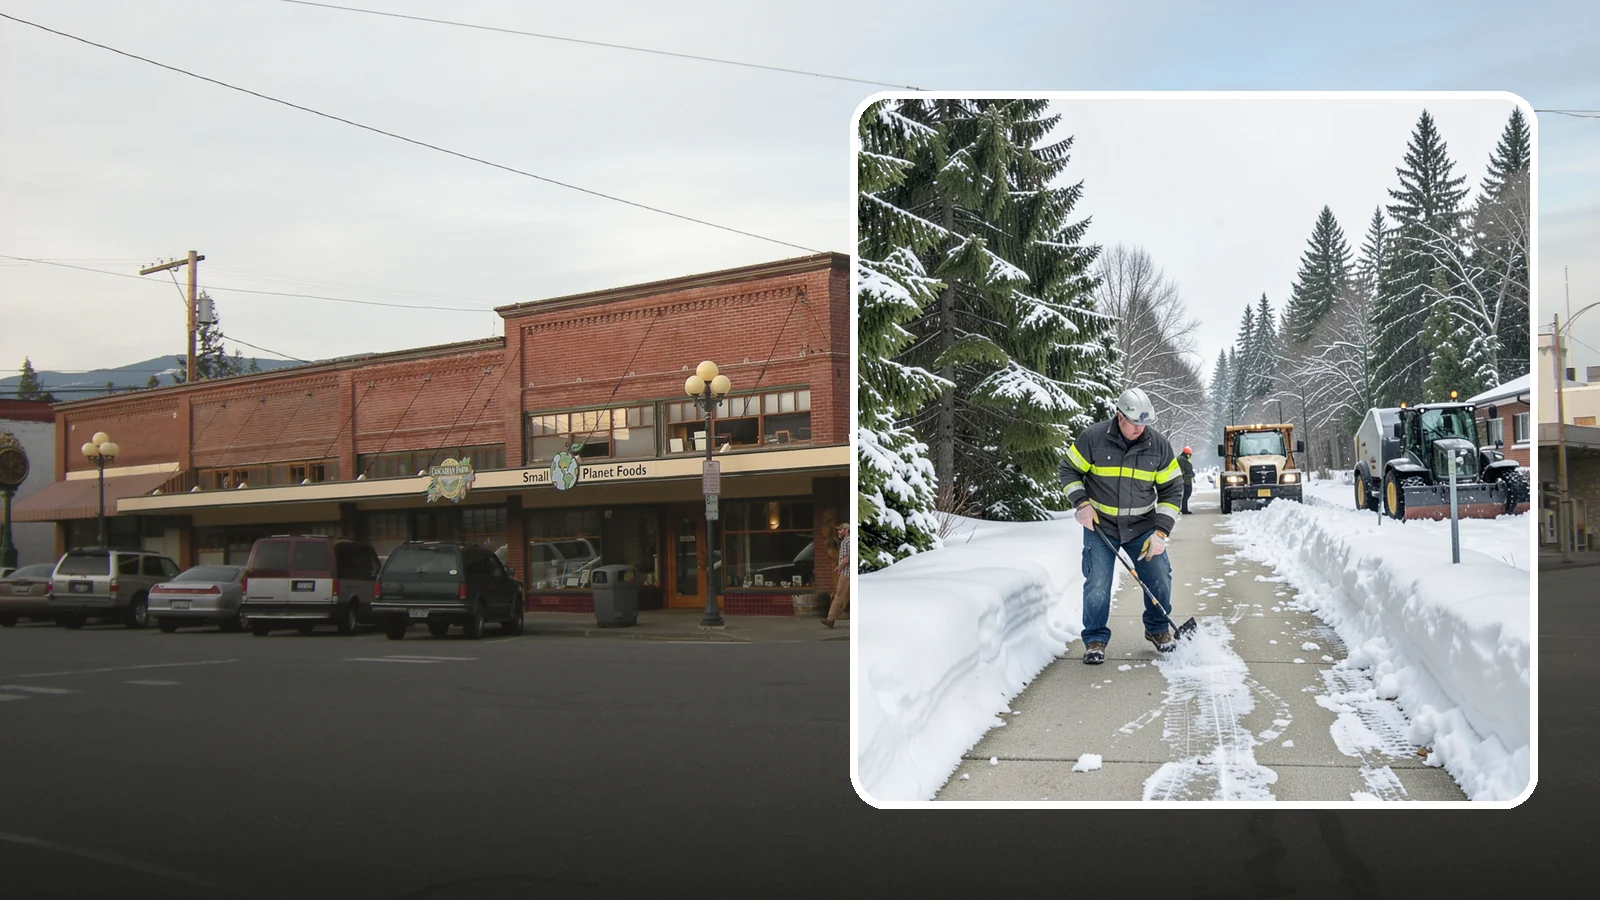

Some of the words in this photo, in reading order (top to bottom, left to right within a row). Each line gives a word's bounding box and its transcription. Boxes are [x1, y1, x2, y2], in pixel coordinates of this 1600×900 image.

[523, 471, 549, 483] Small
[583, 466, 614, 479] Planet
[617, 463, 647, 476] Foods
